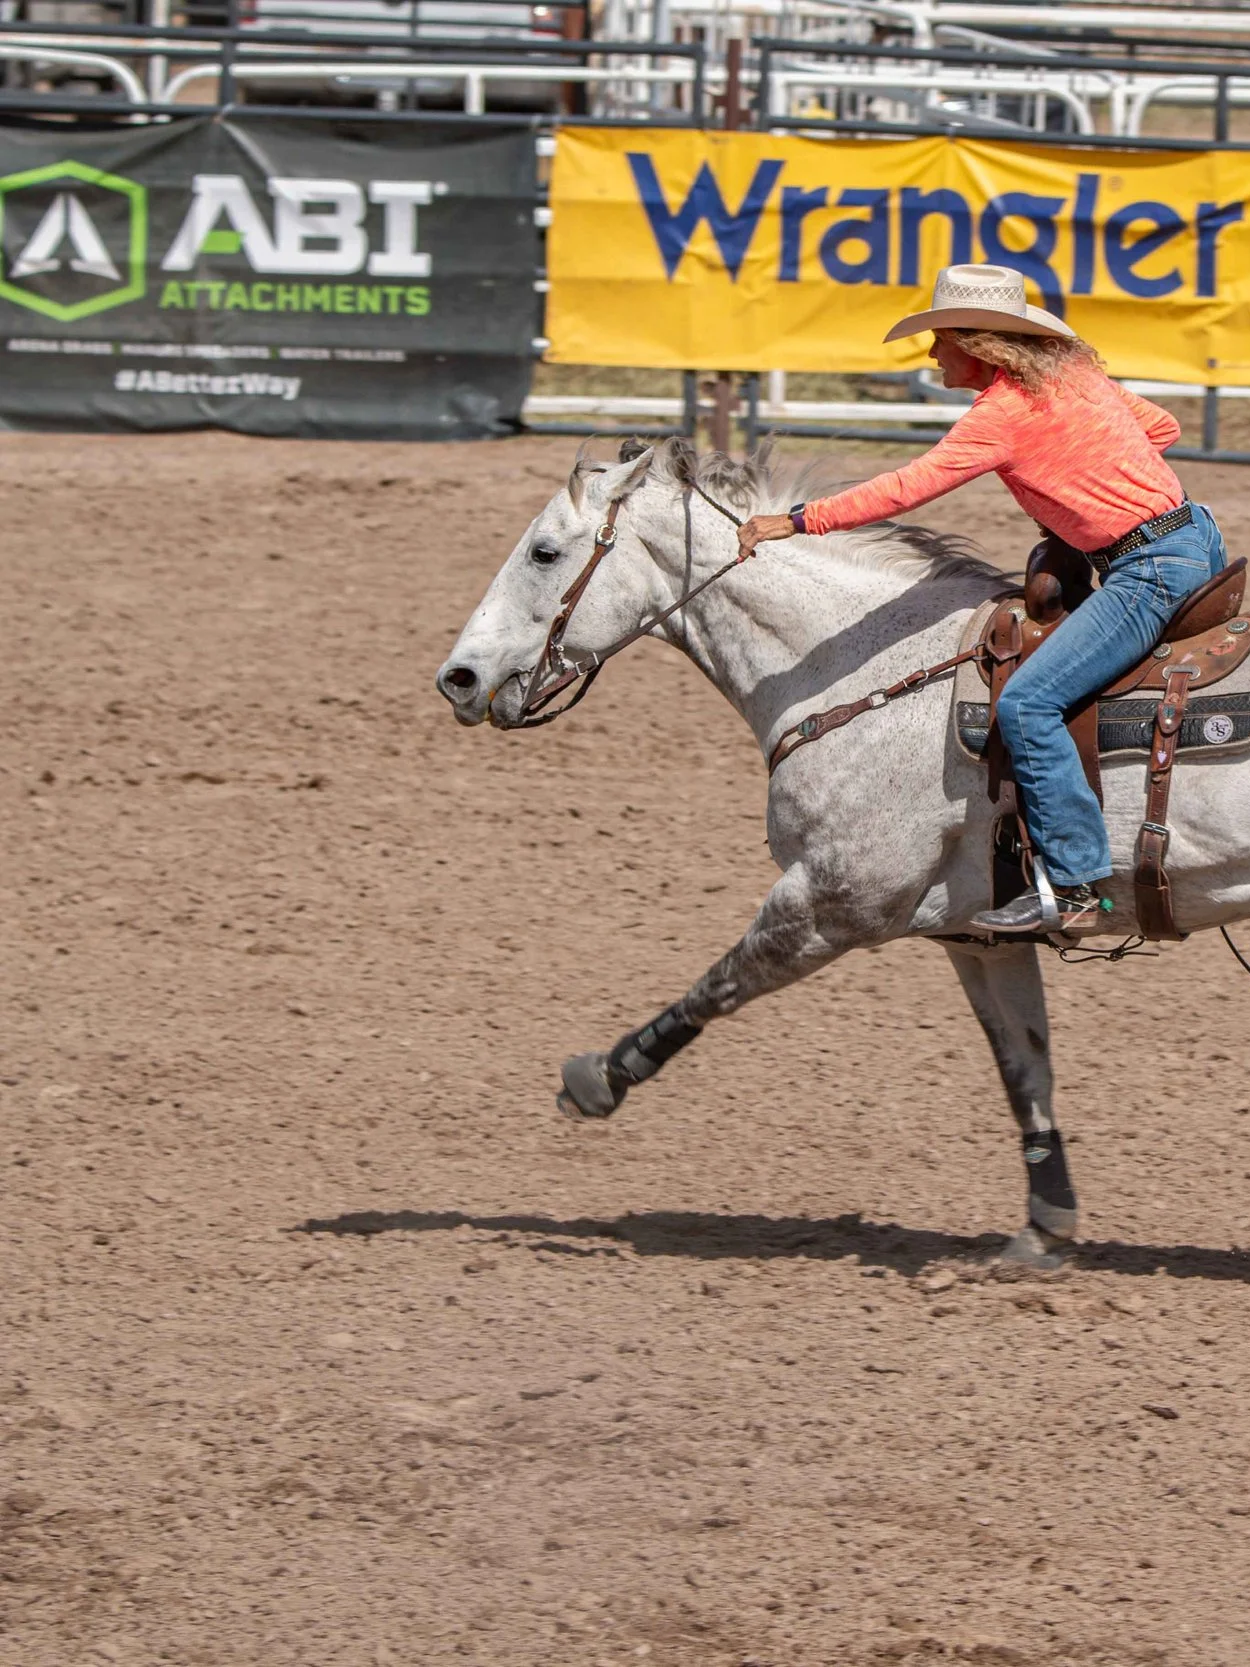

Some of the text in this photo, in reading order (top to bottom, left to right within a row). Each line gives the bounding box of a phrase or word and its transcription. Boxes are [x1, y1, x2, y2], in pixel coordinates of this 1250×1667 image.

[161, 174, 432, 277] ABI
[626, 152, 1244, 319] Wrangler
[160, 281, 431, 315] ATTACHMENTS
[115, 369, 301, 400] #ABetterWay
